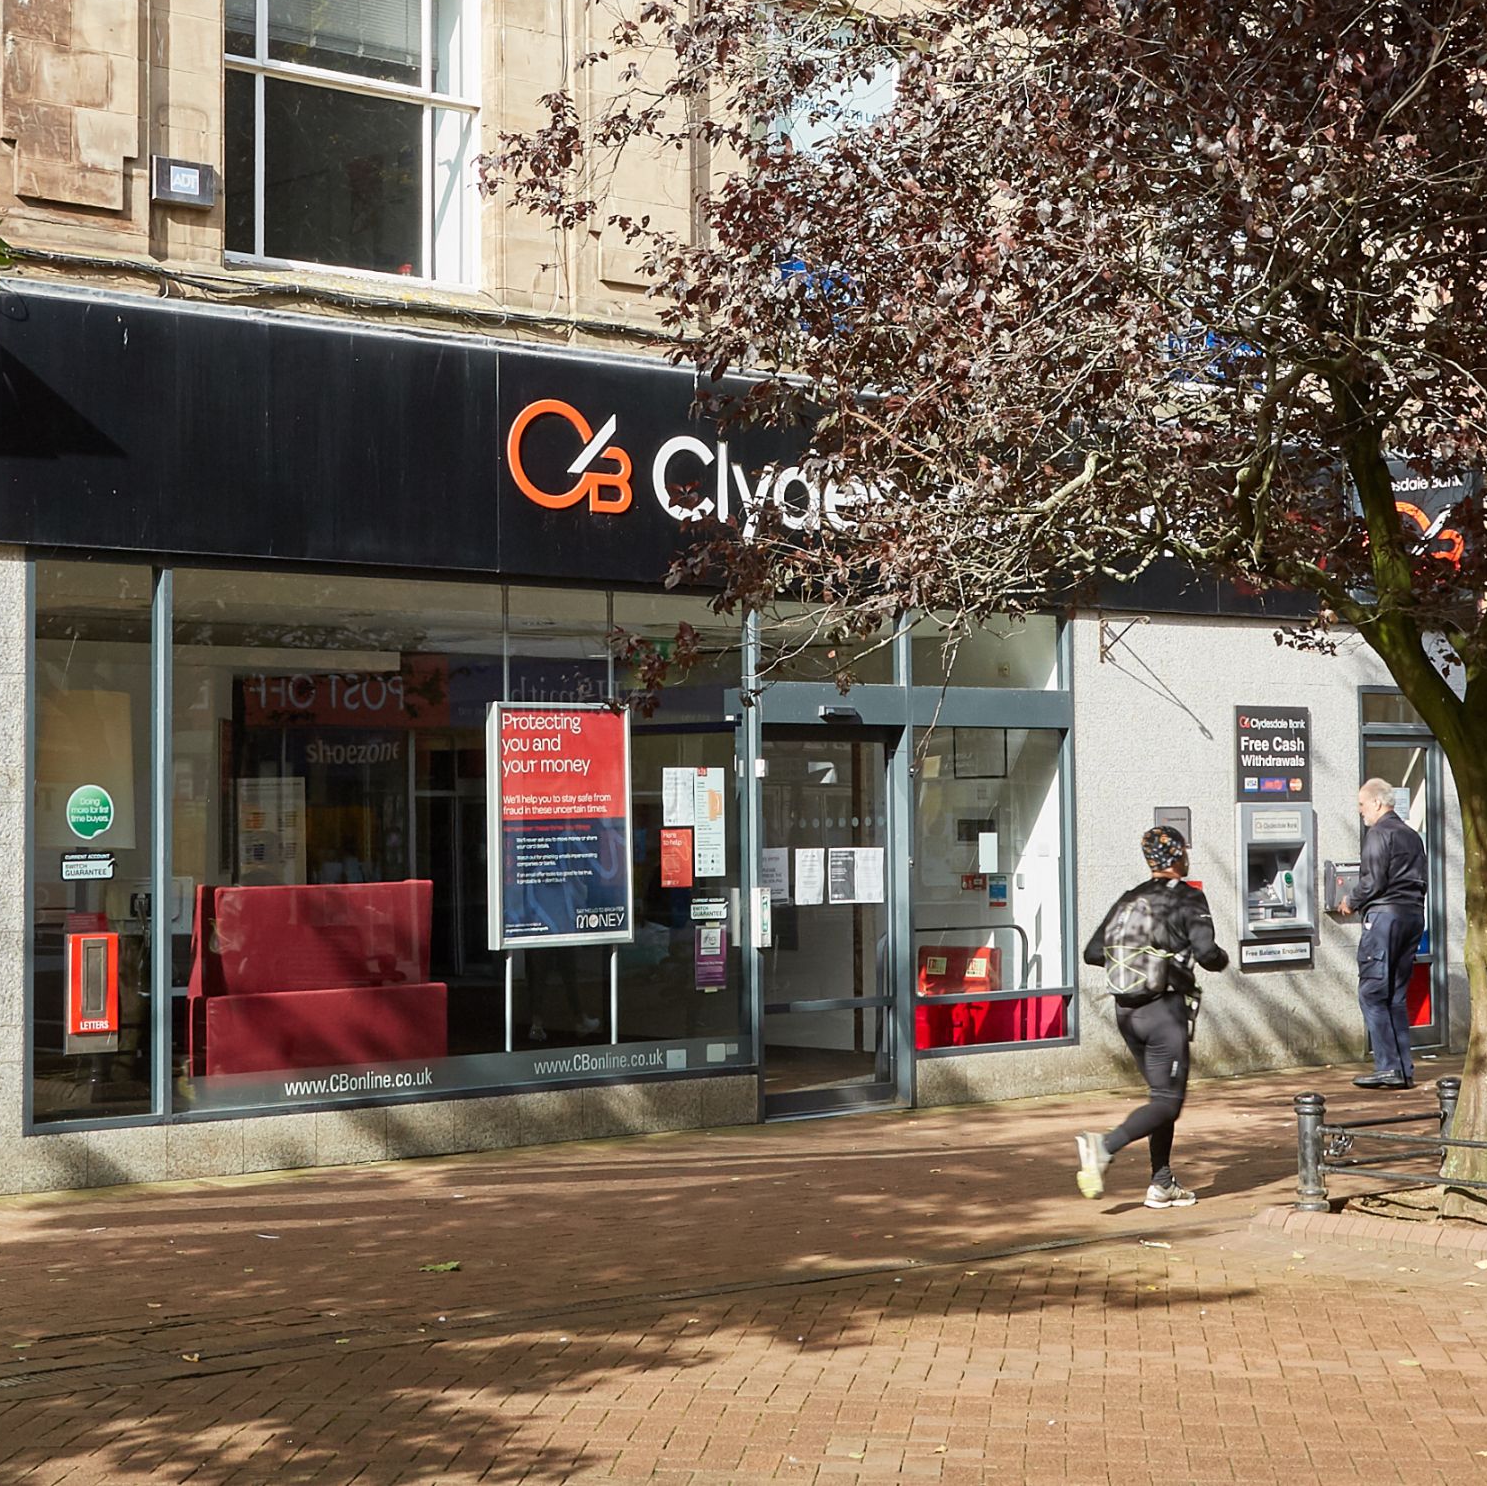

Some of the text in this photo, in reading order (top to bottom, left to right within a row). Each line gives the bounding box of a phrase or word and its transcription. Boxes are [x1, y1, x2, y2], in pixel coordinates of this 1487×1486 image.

[173, 173, 198, 189] ADT
[502, 713, 581, 734] Protecting
[1250, 718, 1288, 730] Clydesdale
[1289, 719, 1305, 729] Bank
[502, 734, 561, 755] you and
[1240, 736, 1305, 752] Free Cash
[502, 758, 591, 777] your money
[1241, 754, 1305, 767] Withdrawals
[503, 792, 612, 805] We'll help you to stay safe from
[502, 803, 608, 815] fraud in these uncertain times.
[80, 1020, 109, 1030] LETTERS
[534, 1048, 663, 1075] www.CBonline.co.uk
[285, 1067, 433, 1096] www.CBonline.co.uk
